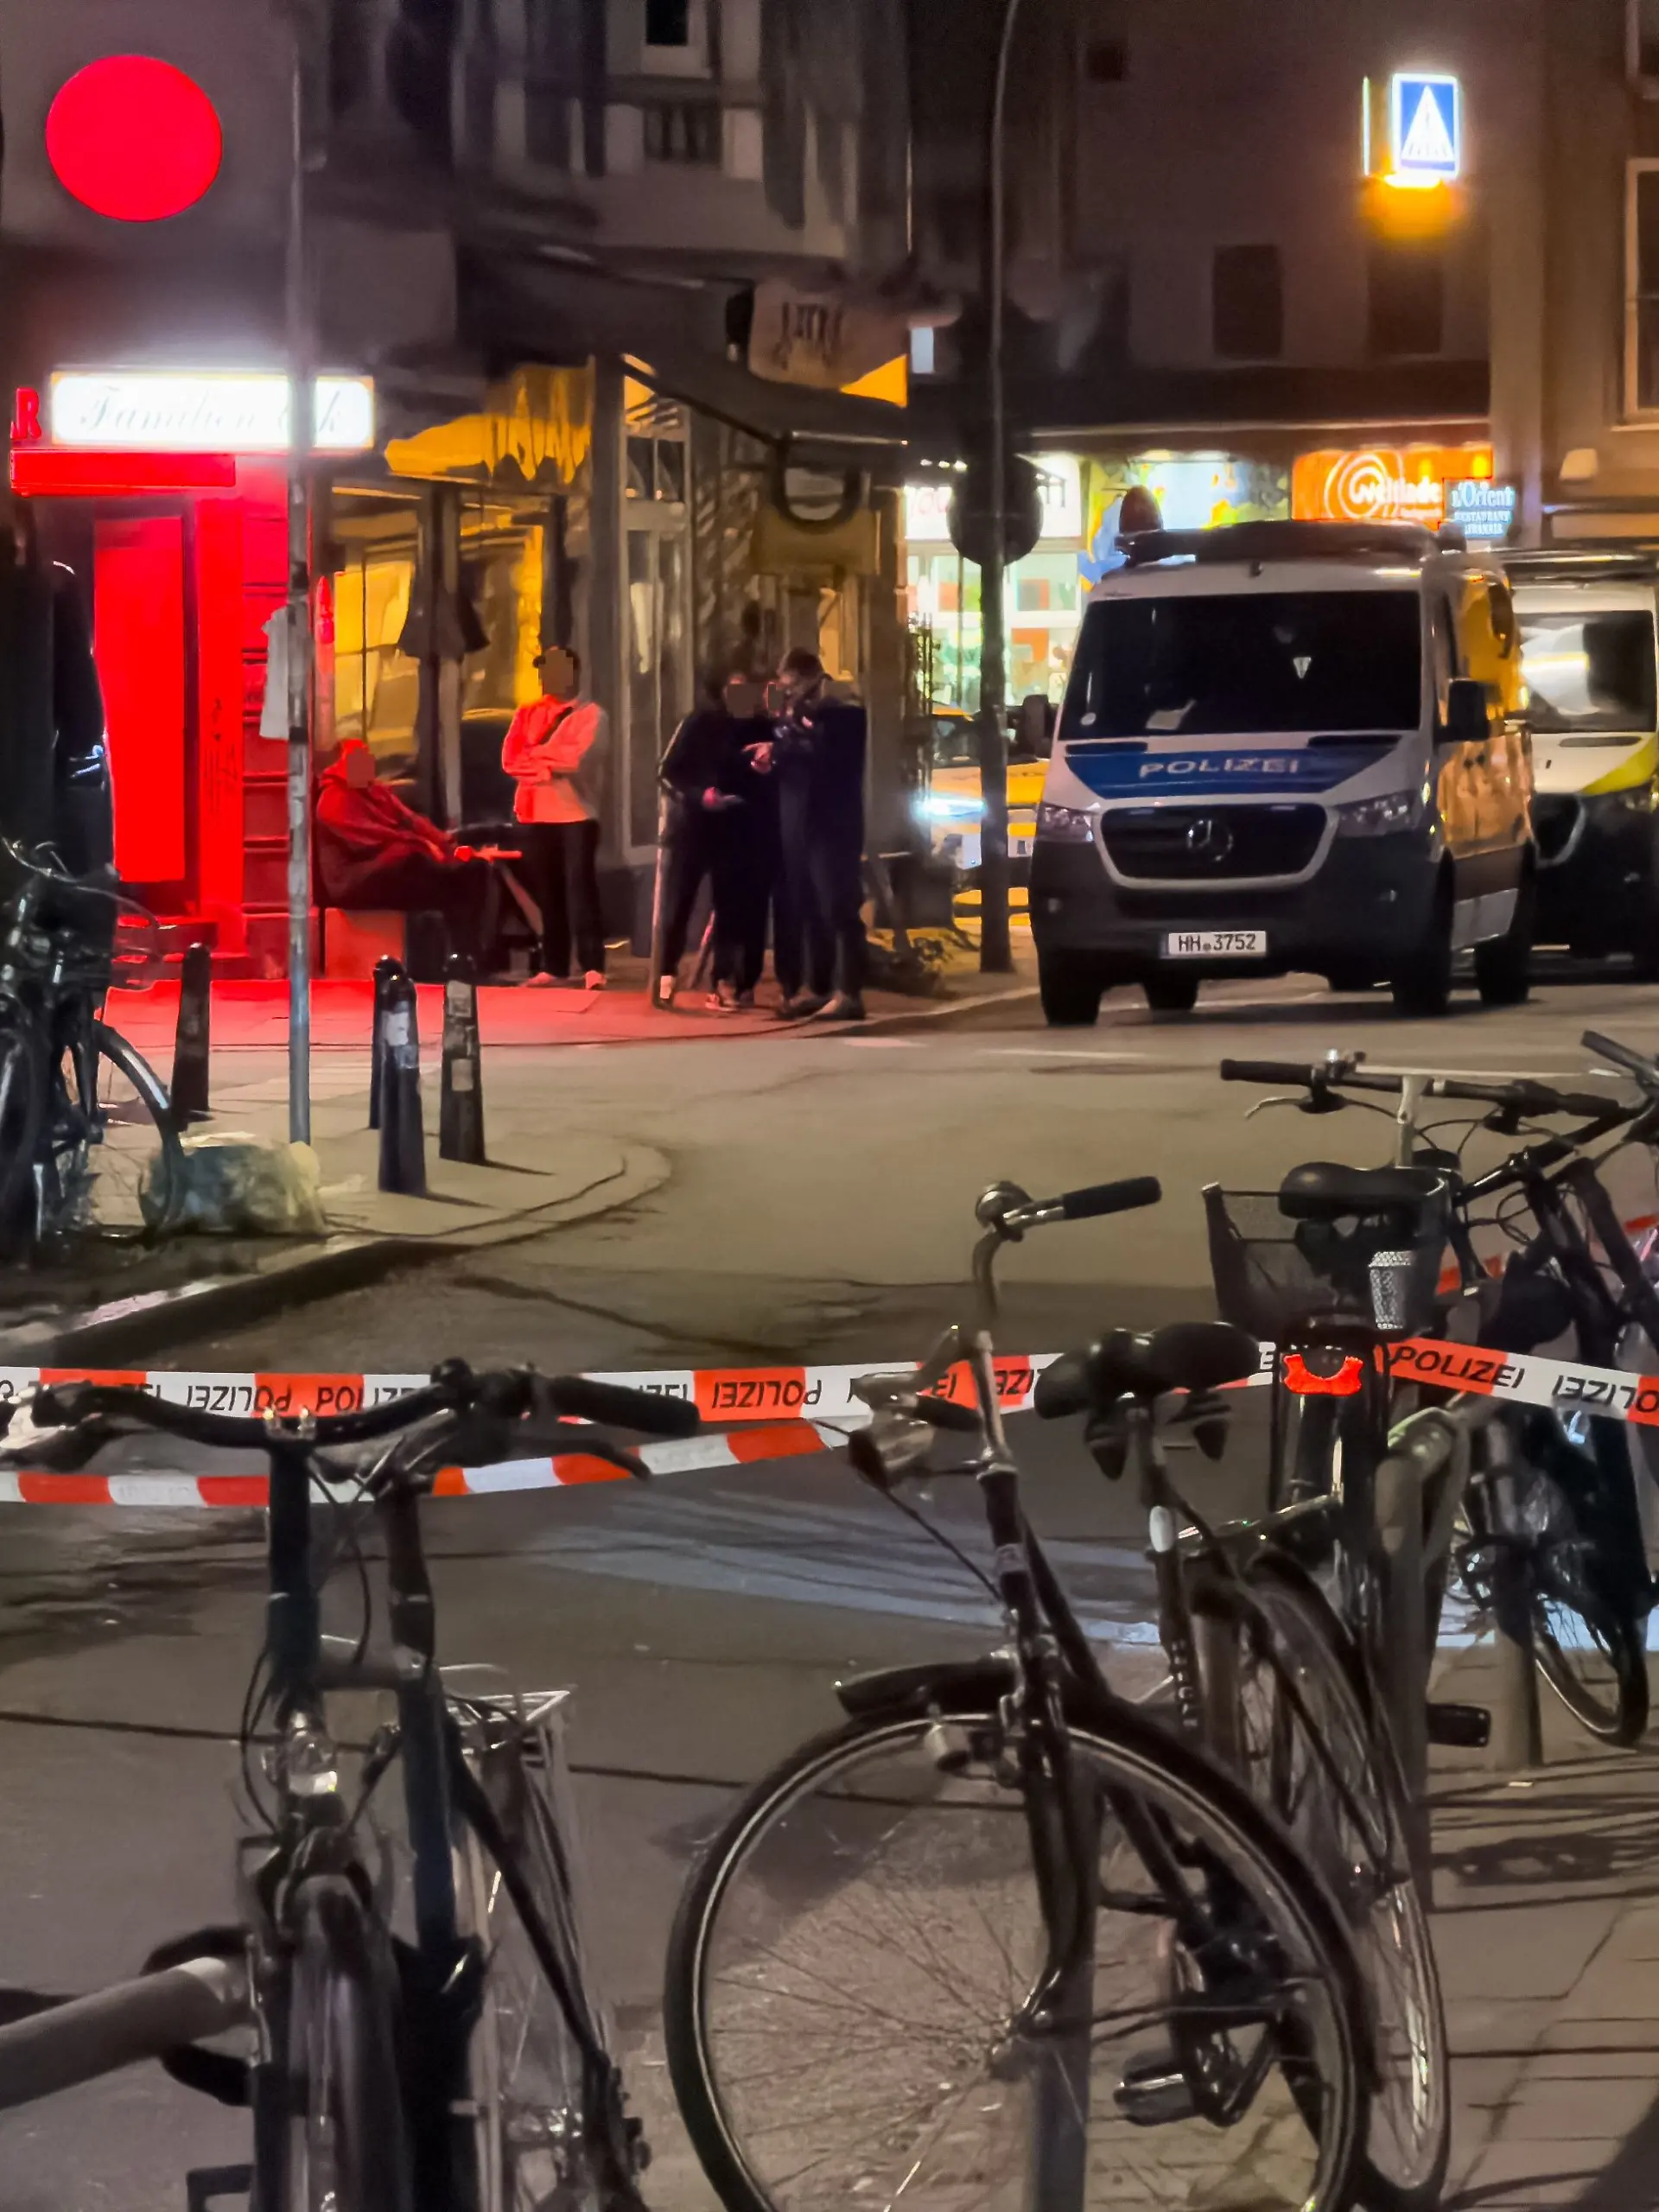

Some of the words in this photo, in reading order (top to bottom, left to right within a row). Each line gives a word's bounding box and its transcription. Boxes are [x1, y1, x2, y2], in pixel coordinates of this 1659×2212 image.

[10, 387, 42, 439] R
[1139, 756, 1300, 778] POLIZEI
[1179, 935, 1200, 952] HH
[1213, 933, 1256, 951] 3752
[1390, 1345, 1526, 1389] POLIZEI
[186, 1384, 293, 1413] POLIZEI
[712, 1379, 822, 1409] POLIZEI
[1552, 1375, 1659, 1414] OLIZEI
